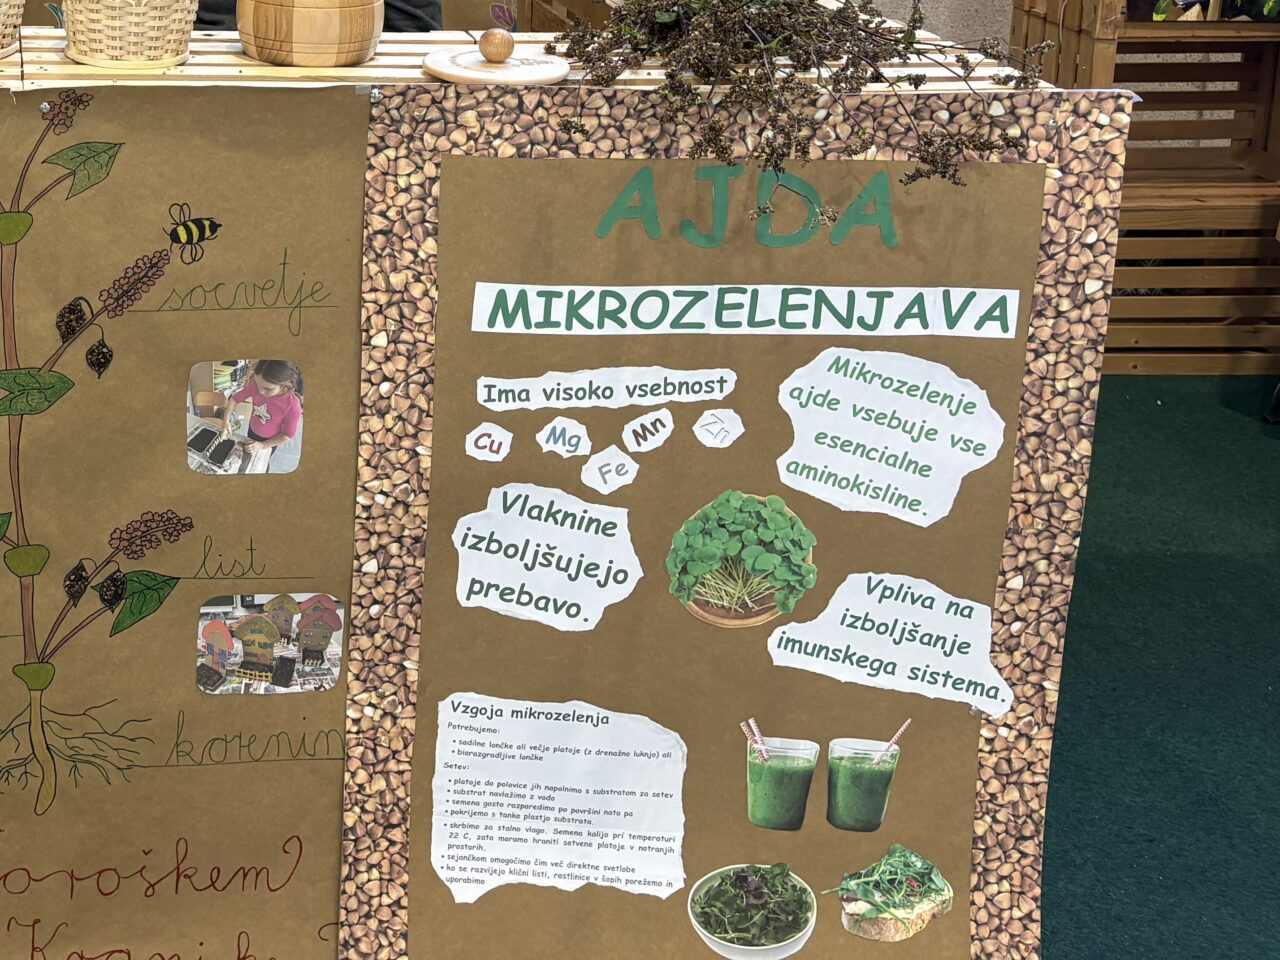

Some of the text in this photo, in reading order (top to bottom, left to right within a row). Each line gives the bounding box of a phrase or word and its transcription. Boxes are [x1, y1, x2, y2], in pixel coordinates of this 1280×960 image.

[595, 165, 900, 249] AJDA
[157, 247, 332, 337] socvetje
[486, 287, 1011, 335] MIKROZELENJAVA
[482, 375, 729, 404] Ima visoko vsebnost
[826, 353, 978, 418] Mikrozelenje
[631, 414, 667, 448] Mn
[697, 414, 732, 444] Zn
[788, 383, 988, 458] ajde vsebuje vse
[472, 430, 503, 457] Cu
[544, 427, 582, 454] Mg
[814, 427, 934, 480] esencialne
[596, 460, 630, 486] Fe
[785, 457, 929, 518] aminokisline.
[500, 490, 620, 540] Vlaknine
[192, 535, 267, 578] list
[459, 527, 630, 590] izboljšujejo
[465, 577, 591, 624] prebavo.
[862, 574, 976, 621] Vpliva na
[839, 607, 974, 659] izboljšanje
[775, 630, 1008, 706] imunskega sistema.
[447, 721, 501, 734] Potrebujemo:
[451, 700, 610, 728] Vzgoja mikrozelenja
[458, 739, 486, 748] sadilne
[489, 741, 514, 750] lončke
[517, 743, 526, 751] ali
[529, 744, 550, 753] večje
[552, 745, 581, 756] platoje
[662, 751, 672, 759] ali
[519, 753, 544, 762] lončke
[443, 761, 470, 771] Setev:
[452, 788, 486, 797] substrat
[489, 790, 527, 799] navlažimo
[537, 794, 556, 802] vodo
[453, 777, 481, 788] platoje
[484, 779, 494, 787] do
[496, 780, 528, 790] polovice
[530, 783, 542, 791] jih
[592, 788, 637, 797] substratom
[448, 831, 459, 839] 22
[532, 837, 559, 846] hraniti
[563, 840, 593, 848] setvene
[597, 841, 626, 852] platoje
[638, 846, 675, 855] notranjih
[449, 822, 480, 831] skrbimo
[552, 828, 583, 837] Semena
[587, 830, 609, 840] kalijo
[612, 832, 625, 840] pri
[628, 833, 676, 843] temperaturi
[533, 858, 548, 867] čim
[550, 860, 564, 868] več
[566, 861, 600, 871] direktne
[603, 865, 636, 874] svetlobe
